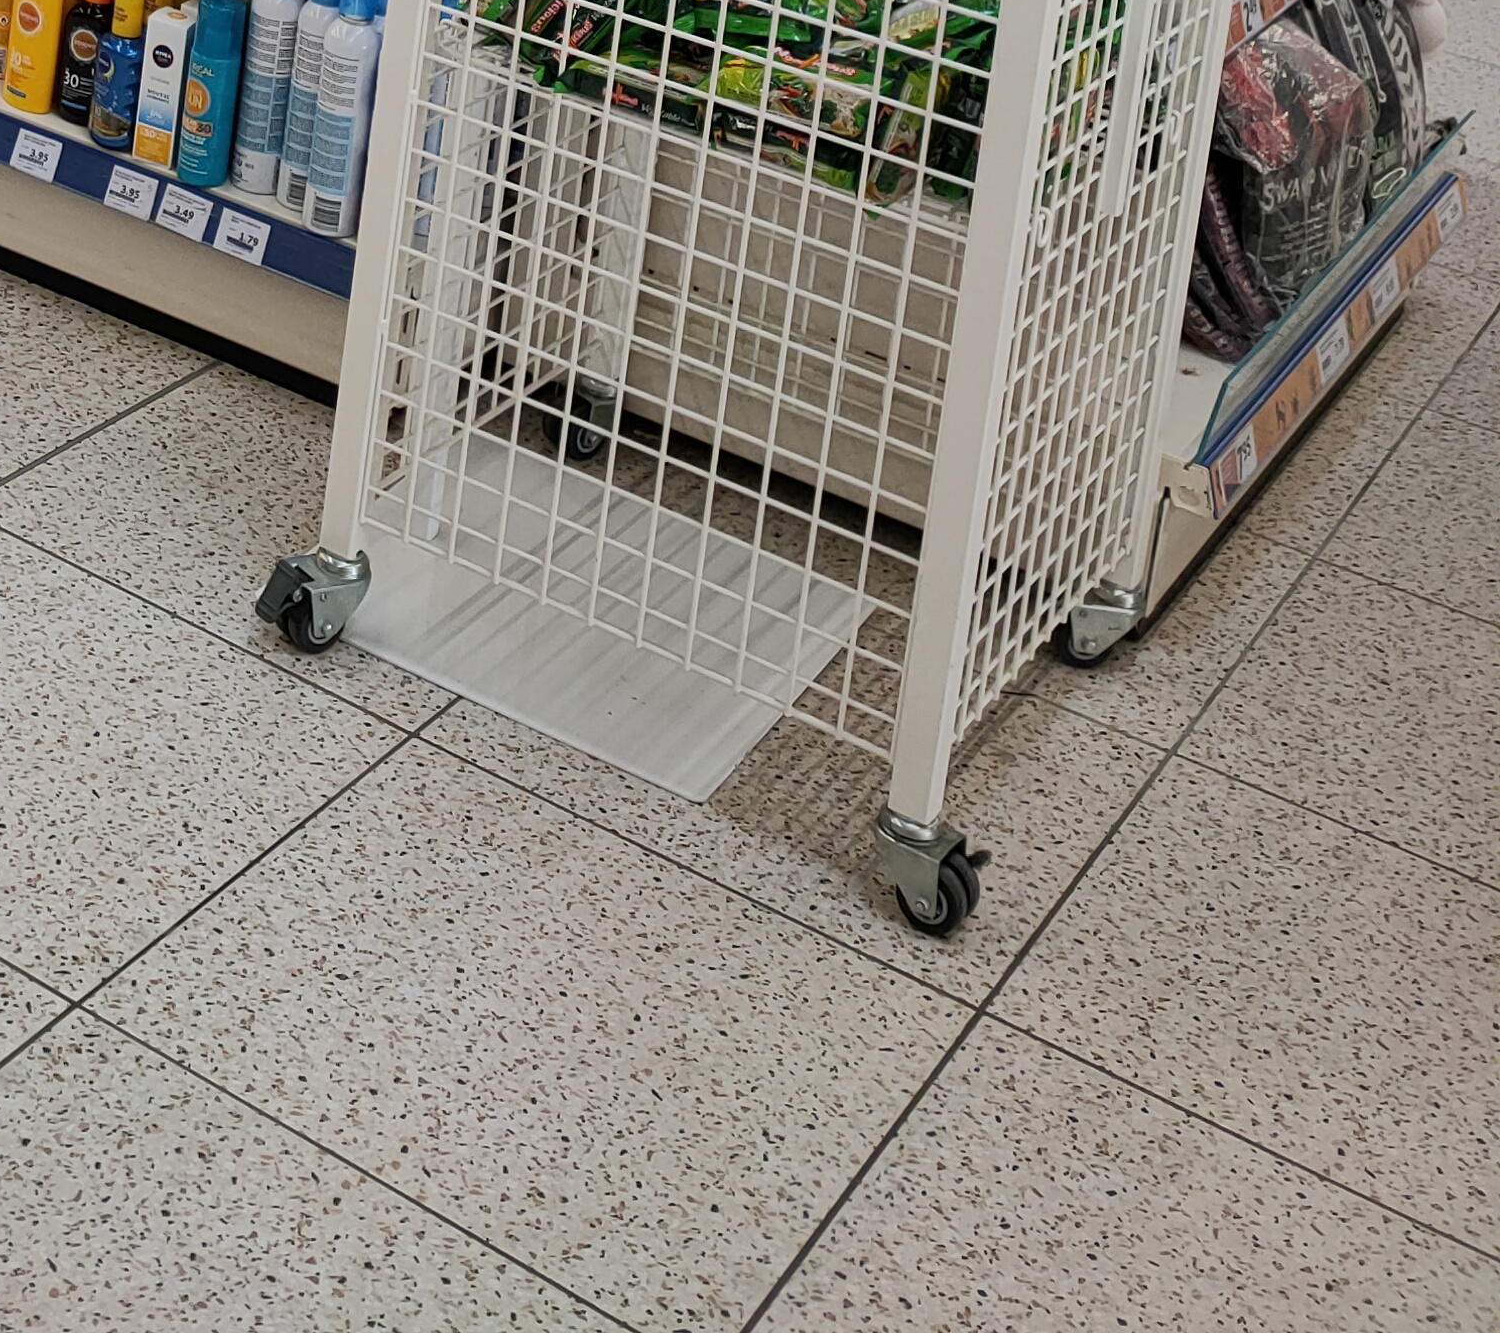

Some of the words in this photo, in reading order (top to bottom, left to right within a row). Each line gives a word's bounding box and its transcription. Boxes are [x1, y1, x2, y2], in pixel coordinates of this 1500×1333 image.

[63, 70, 80, 88] 30
[29, 147, 50, 164] 3.95
[119, 183, 141, 200] 3.95
[174, 204, 196, 221] 3.49
[237, 231, 261, 249] 1.79
